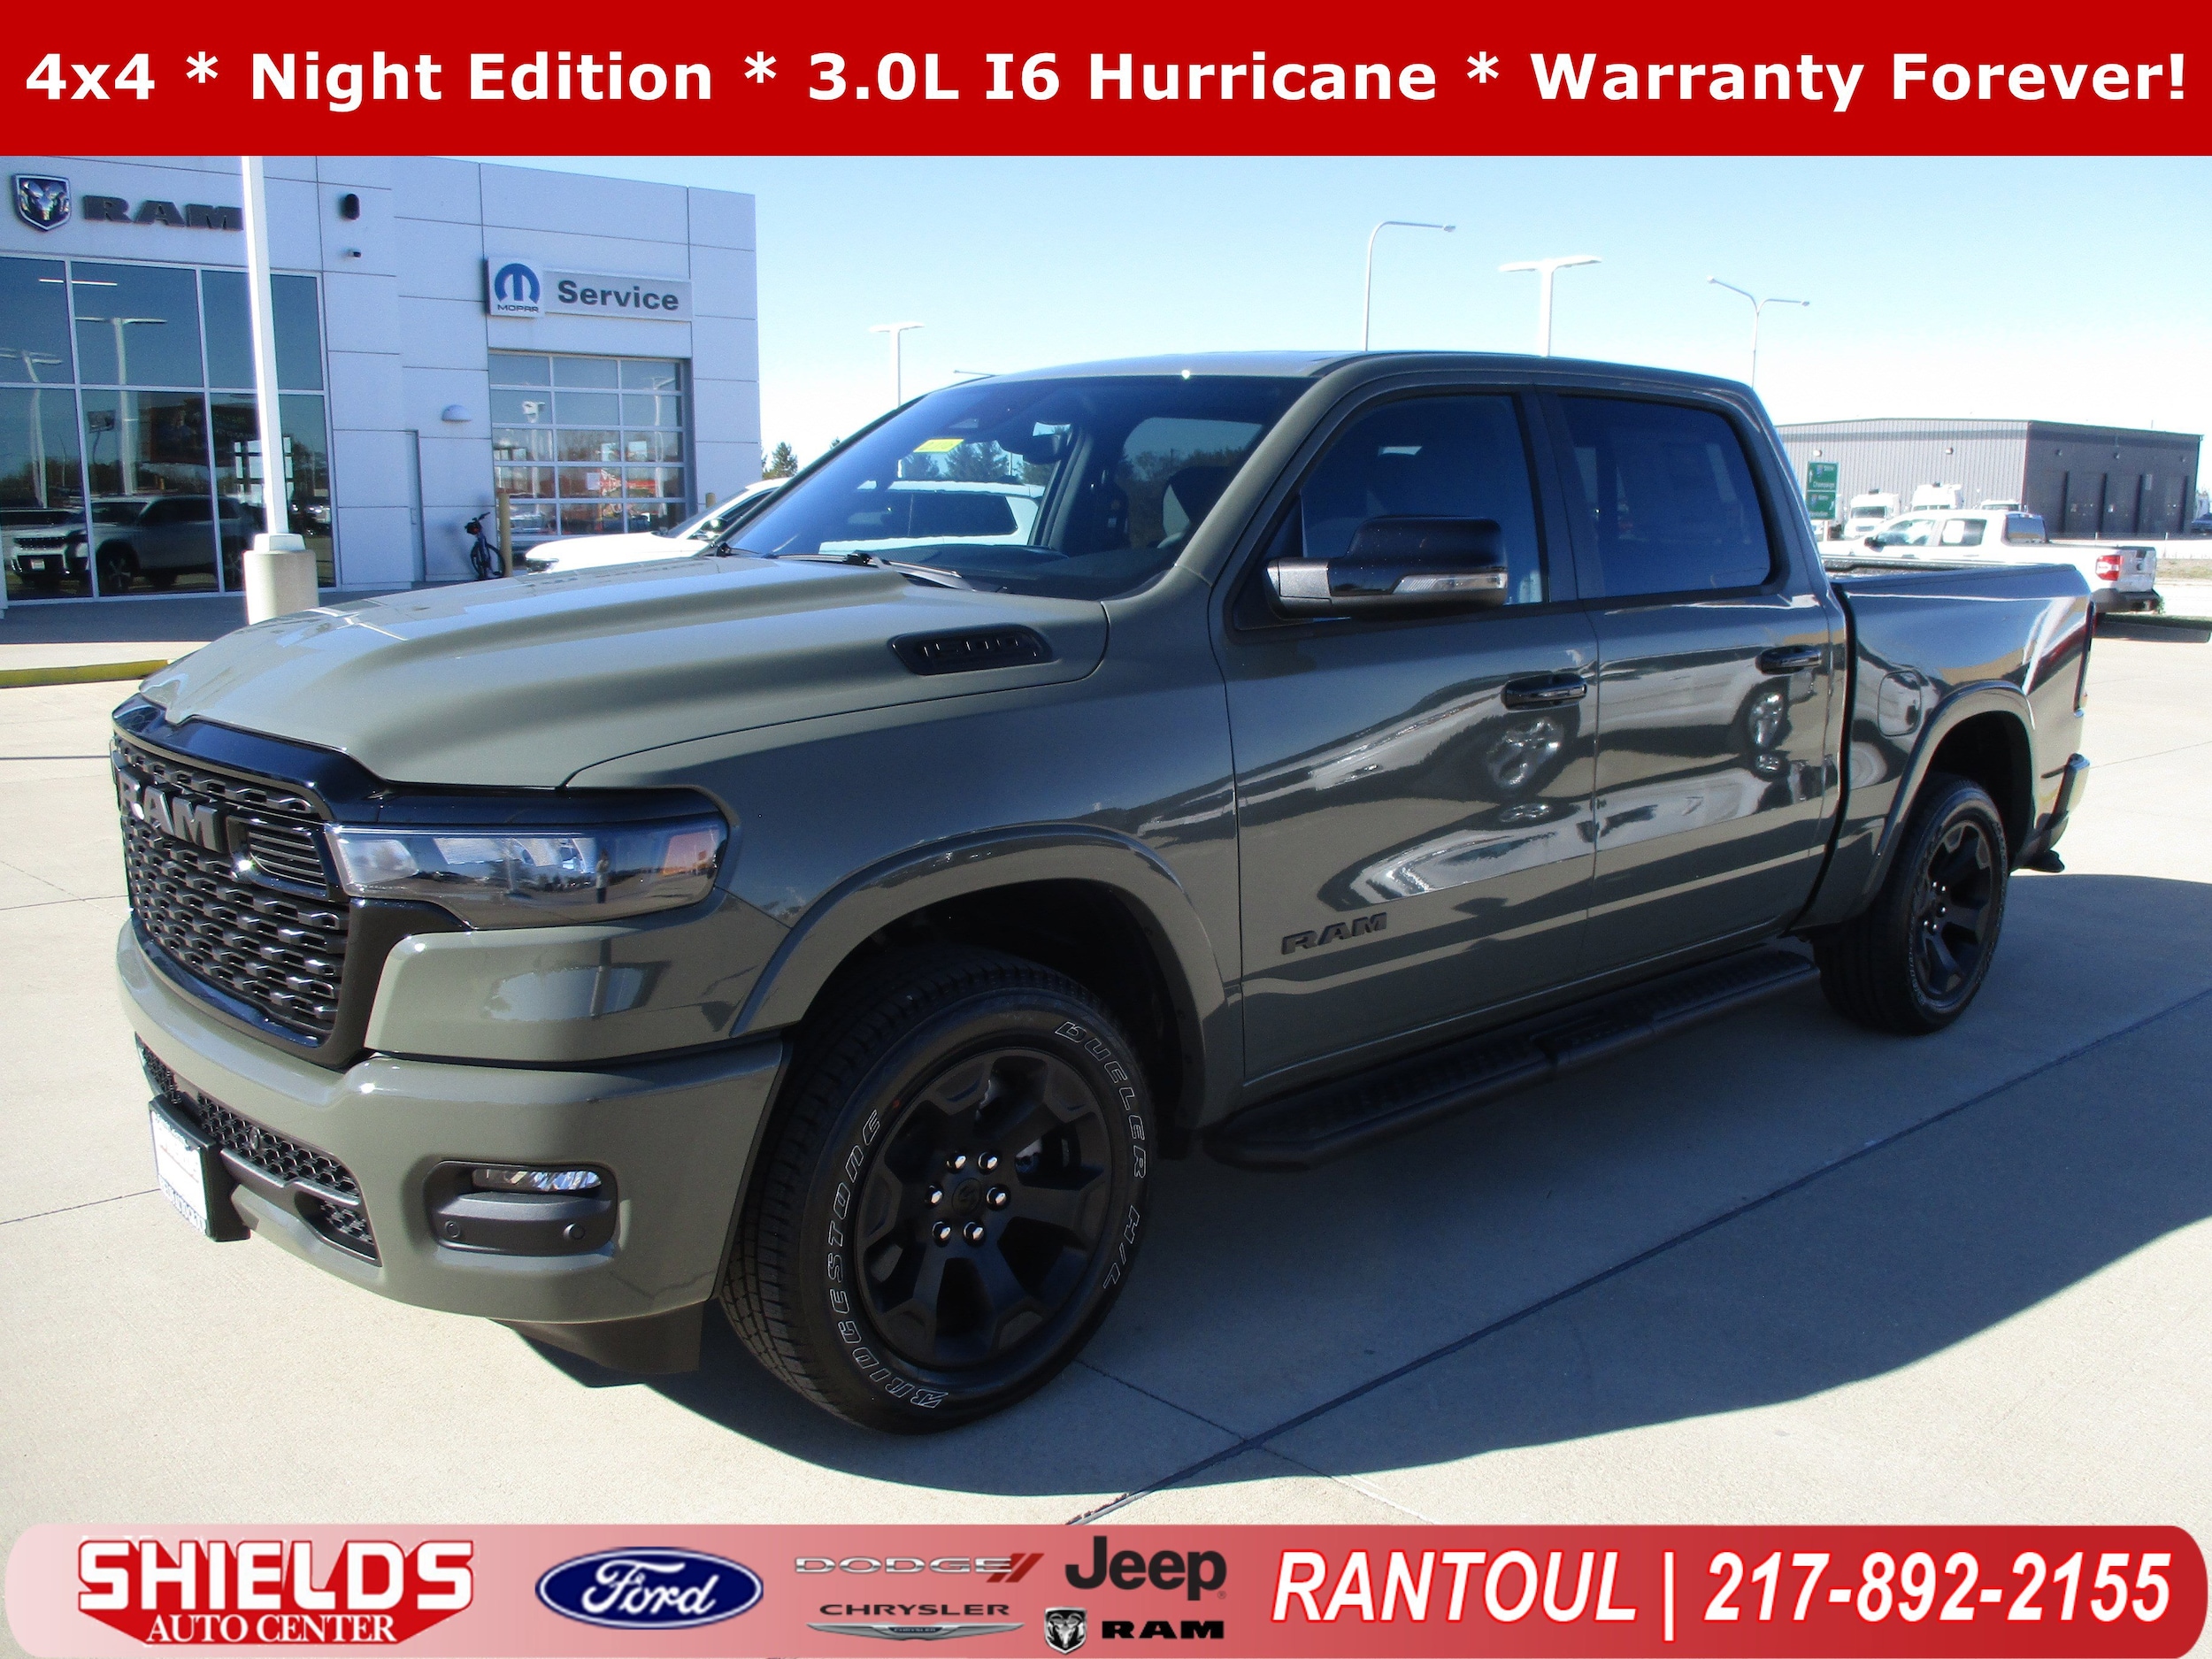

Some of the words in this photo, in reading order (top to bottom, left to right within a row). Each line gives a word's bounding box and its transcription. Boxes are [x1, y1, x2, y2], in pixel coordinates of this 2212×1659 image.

[82, 195, 243, 231] RAM
[497, 303, 539, 312] MOPAR
[557, 280, 679, 311] Service
[119, 768, 226, 854] RAM
[1281, 911, 1387, 955] RAM
[1054, 1020, 1147, 1178] DUELER
[825, 1108, 949, 1409] BRIDGESTONE
